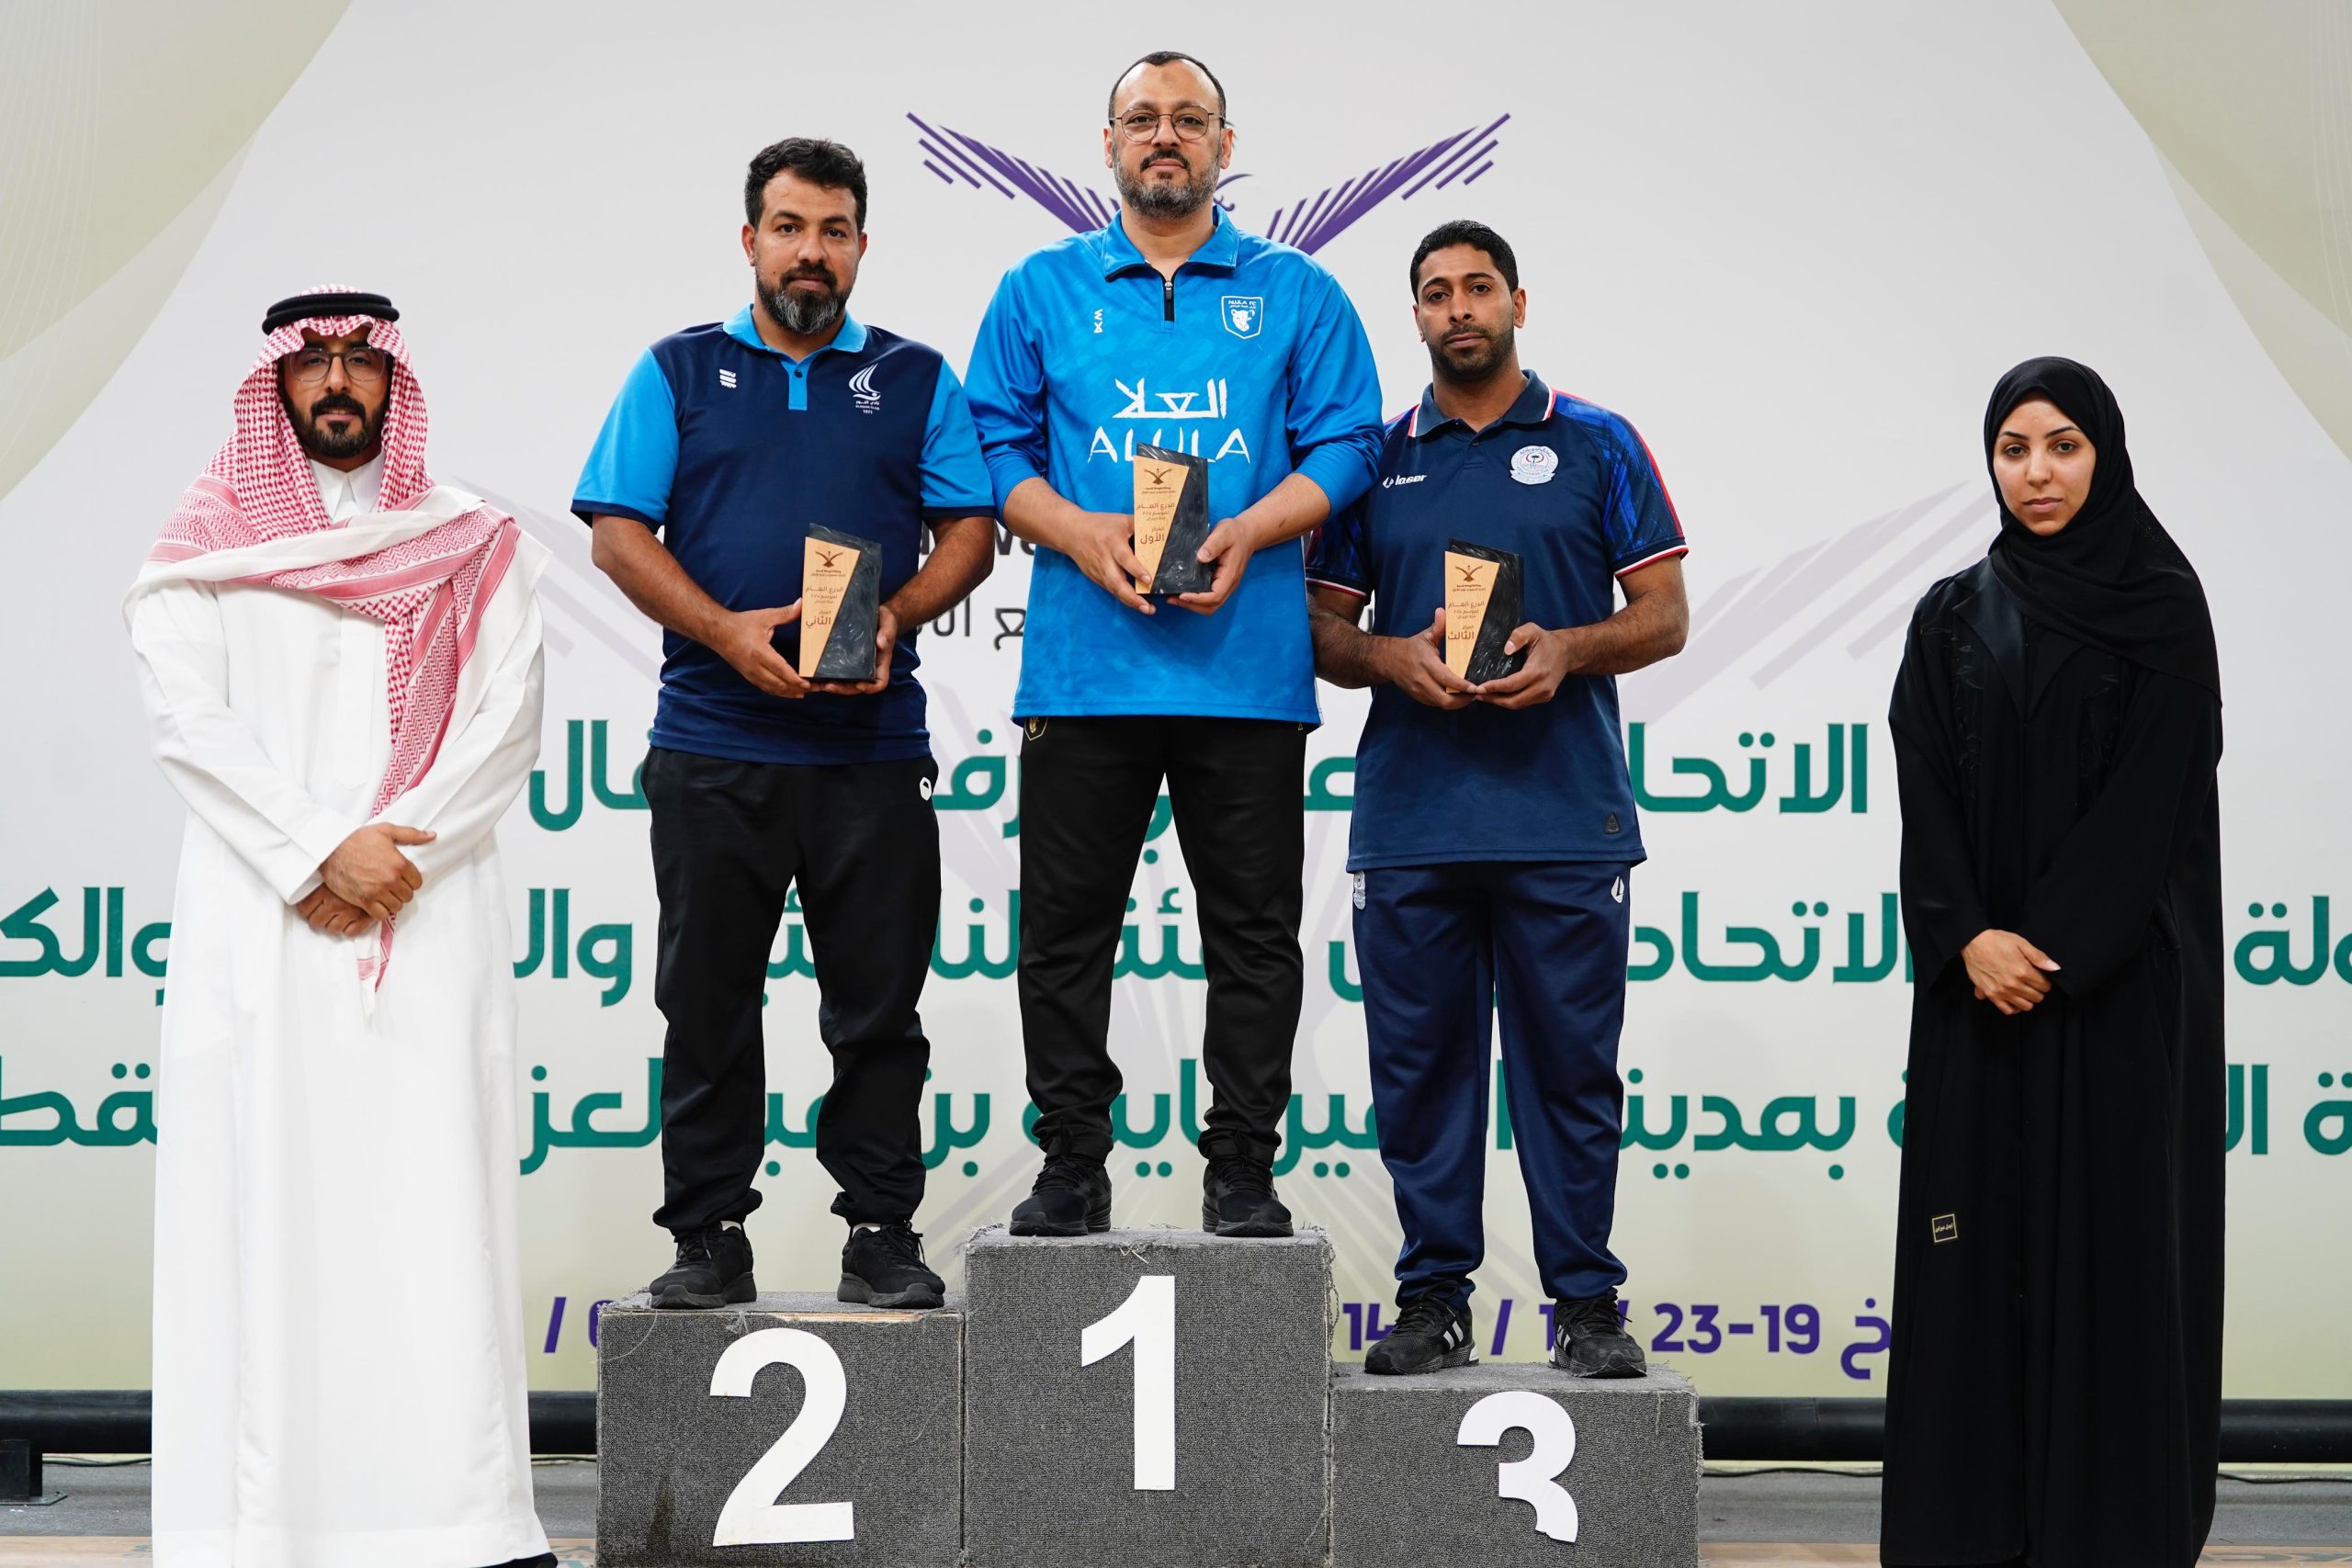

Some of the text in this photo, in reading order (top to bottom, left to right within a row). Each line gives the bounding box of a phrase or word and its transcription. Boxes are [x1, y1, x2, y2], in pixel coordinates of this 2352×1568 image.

[1087, 425, 1250, 463] ALULA
[1395, 474, 1427, 486] laser
[1627, 722, 1869, 814] الاتحا
[1619, 1068, 1856, 1180] بمدين
[1651, 1303, 1820, 1355] 23-19
[1081, 1275, 1175, 1491] 1
[710, 1328, 855, 1547] 2
[1457, 1391, 1578, 1543] 3
